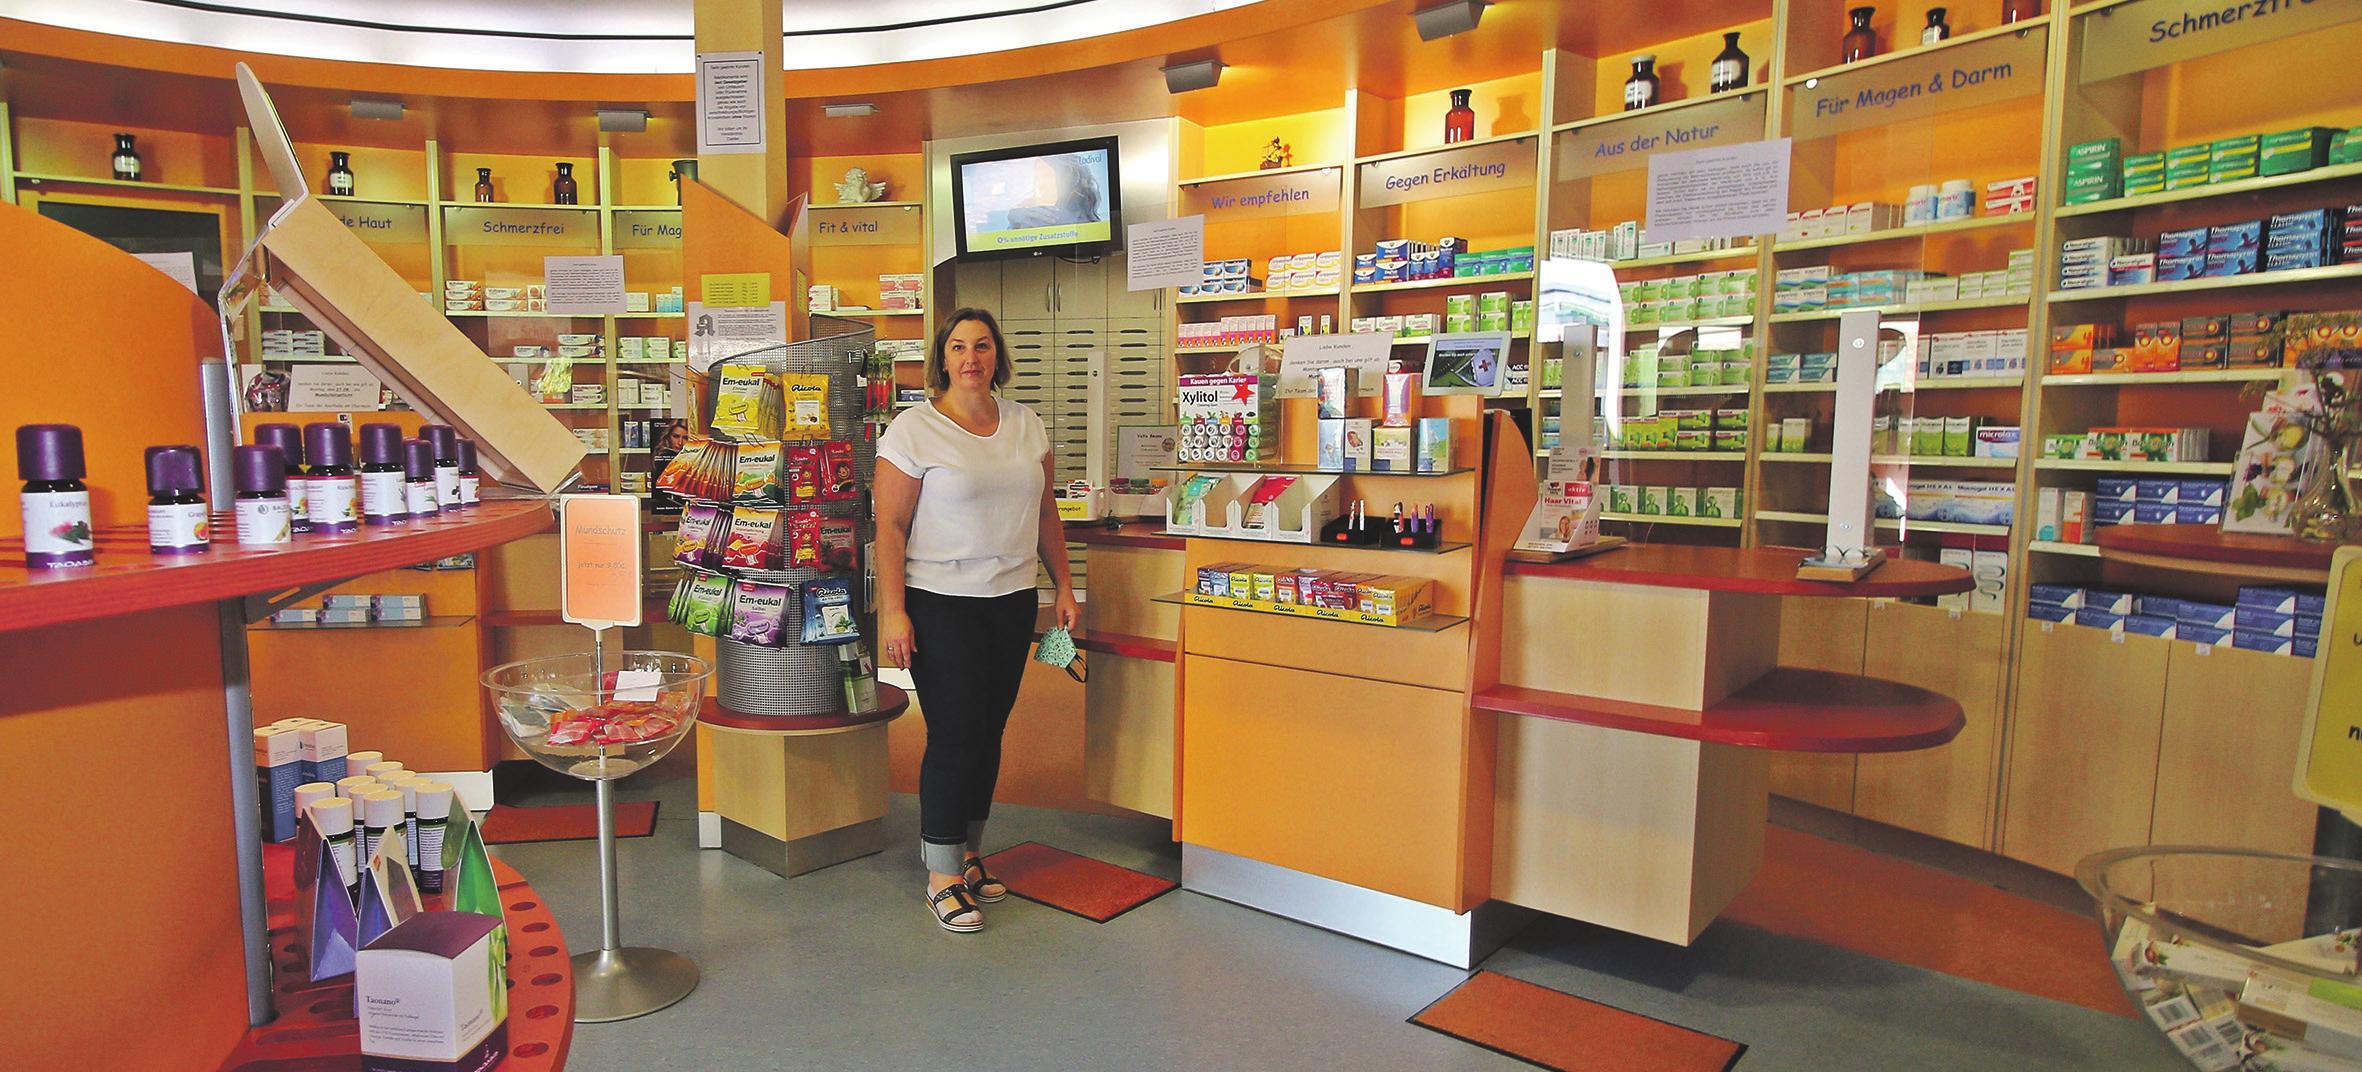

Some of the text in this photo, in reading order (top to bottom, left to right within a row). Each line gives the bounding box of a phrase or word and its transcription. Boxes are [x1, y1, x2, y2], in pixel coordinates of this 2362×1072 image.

[1815, 63, 2012, 118] Für Magen & Darm
[1595, 122, 1720, 158] Aus der Natur
[2077, 143, 2106, 156] ASPIRIN
[1385, 163, 1506, 191] Gegen Erkältung
[2073, 175, 2104, 187] ASPIRIN
[1211, 187, 1310, 209] Wir empfehlen
[359, 216, 392, 229] Haut
[483, 221, 564, 235] Schmerzfrei
[819, 220, 878, 234] Fit & vital
[632, 223, 682, 239] Für Mag
[722, 377, 760, 386] Em-eukal
[1209, 377, 1228, 386] gegen
[791, 383, 822, 392] Ricola
[1182, 390, 1218, 405] Xylitol
[1979, 429, 2018, 439] microlax
[739, 453, 776, 464] Em-eukal
[734, 518, 772, 529] Em-eukal
[821, 526, 851, 535] Em-eukal
[693, 584, 723, 597] Em-eukal
[816, 587, 847, 598] Ricola
[739, 595, 782, 607] Em-eukal
[1193, 595, 1214, 604] Ricola
[1232, 600, 1254, 608] Ricola
[1273, 605, 1296, 613] Ricola
[1316, 609, 1339, 618] Ricola
[1360, 614, 1384, 623] Ricola
